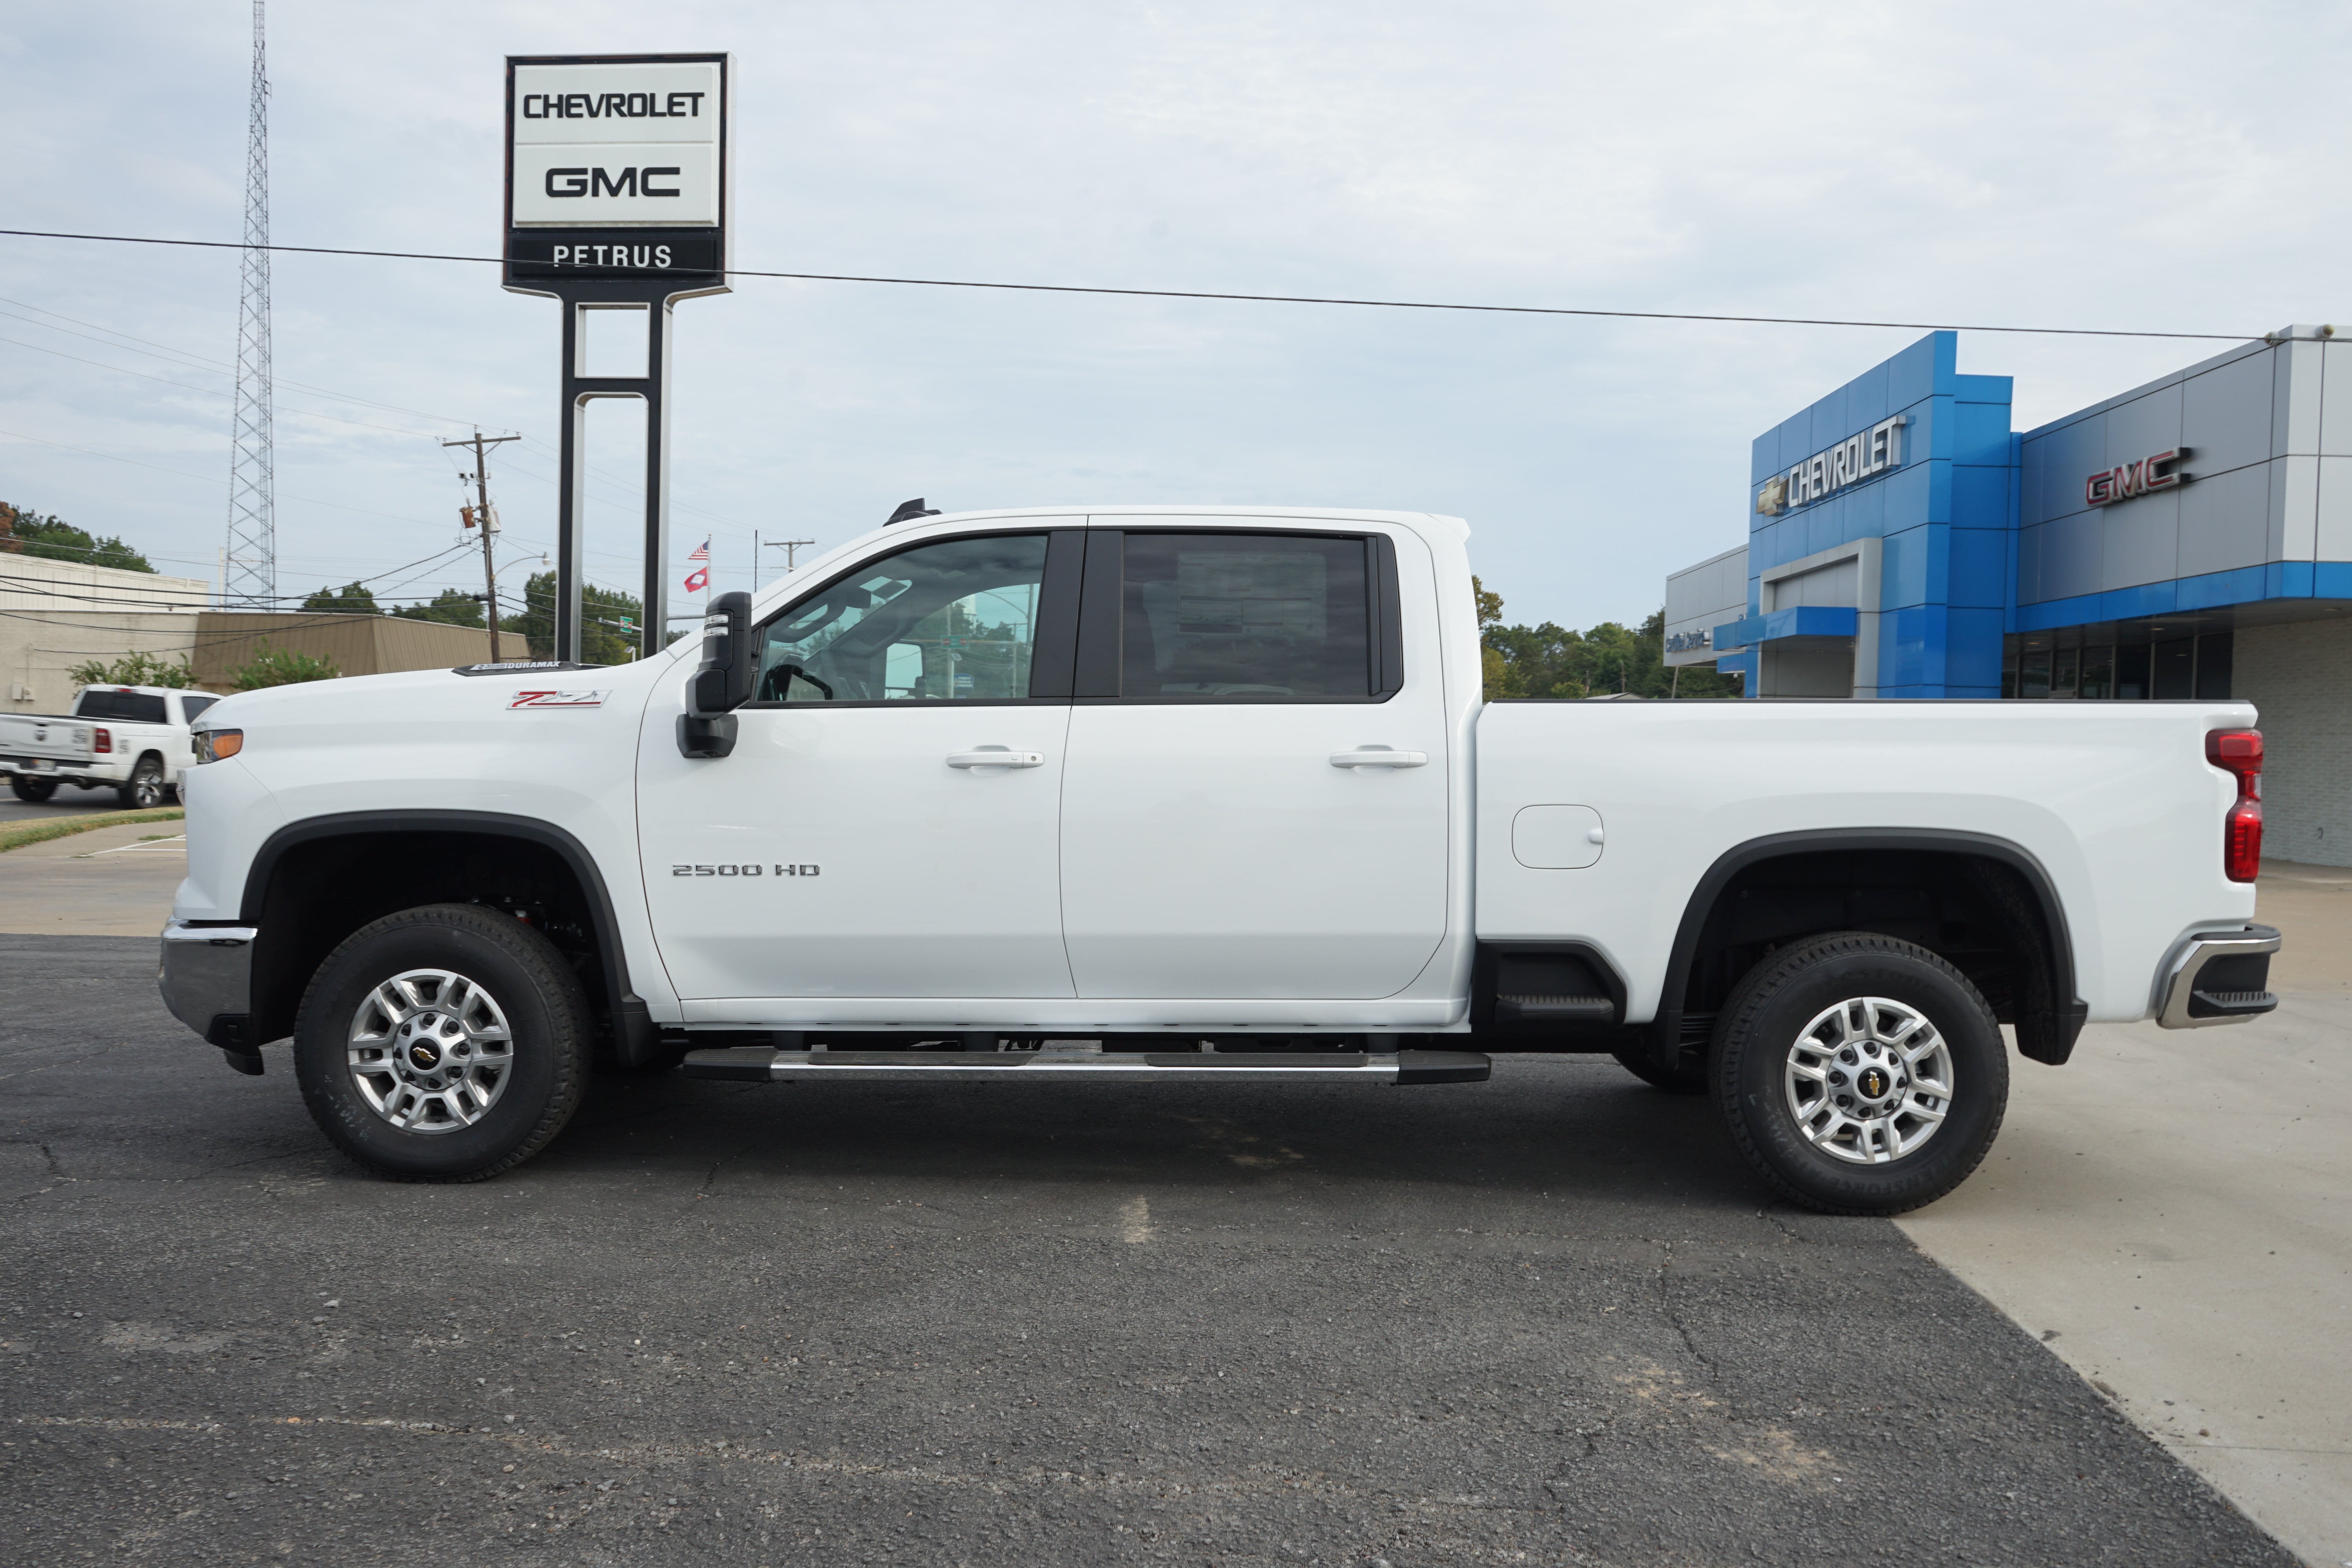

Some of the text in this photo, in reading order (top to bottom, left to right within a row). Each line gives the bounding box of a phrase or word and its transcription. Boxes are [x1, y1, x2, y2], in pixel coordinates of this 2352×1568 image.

[524, 92, 705, 118] CHEVROLET
[545, 167, 681, 197] GMC
[553, 245, 671, 268] PETRUS
[1788, 415, 1906, 508] CHEVROLET
[2085, 446, 2187, 507] GMC
[506, 689, 613, 710] Z71
[673, 864, 820, 876] 2500 HD
